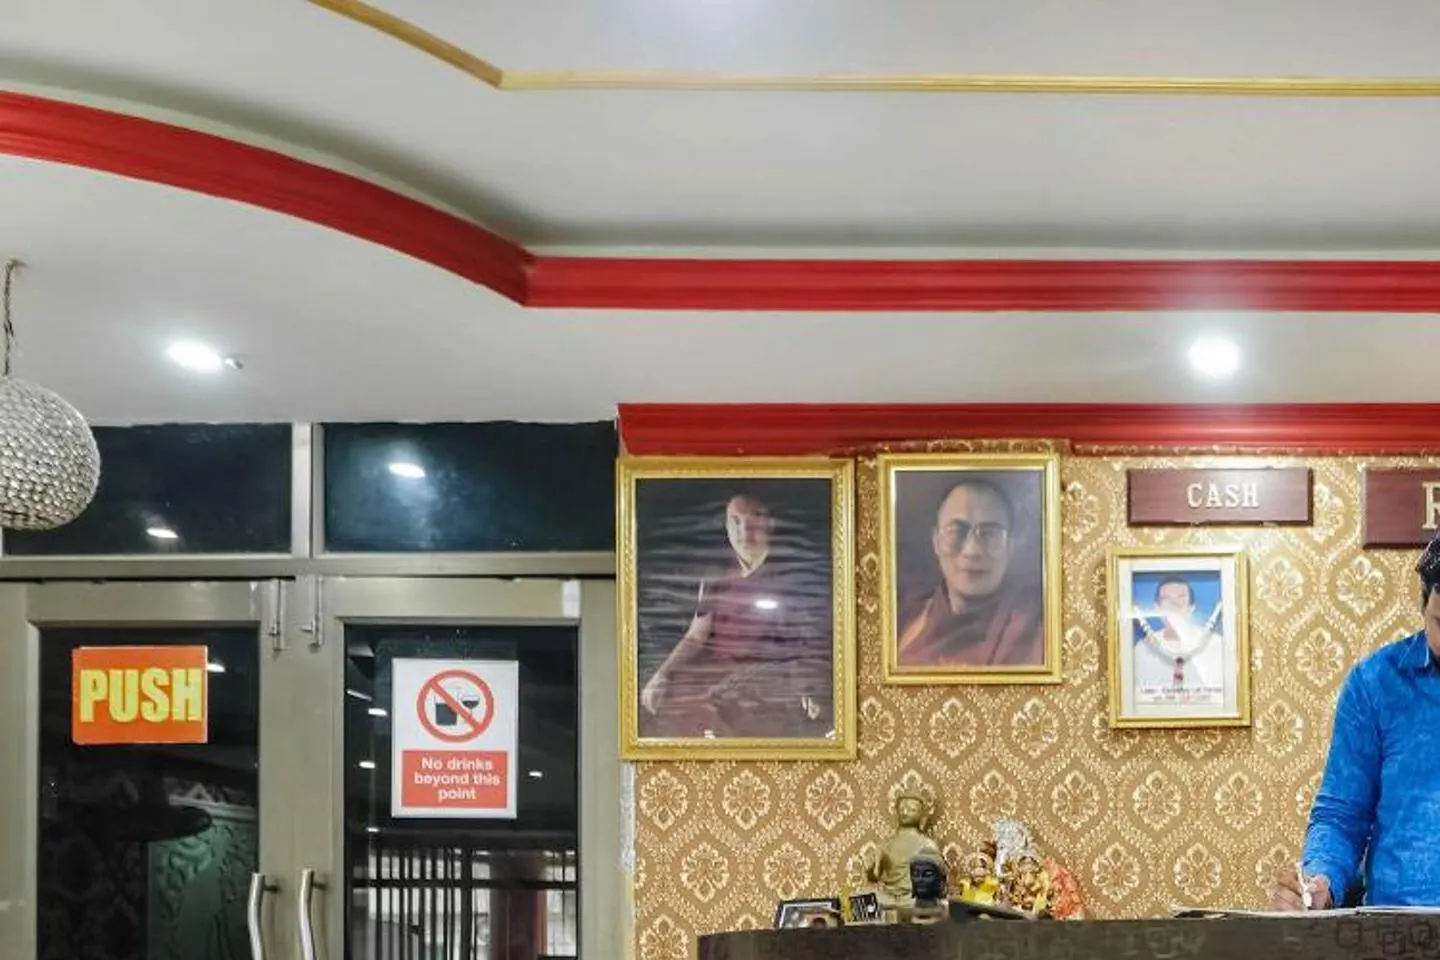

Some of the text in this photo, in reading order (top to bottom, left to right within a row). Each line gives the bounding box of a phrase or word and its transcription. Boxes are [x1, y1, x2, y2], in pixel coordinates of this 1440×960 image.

[1187, 482, 1260, 508] CASH
[79, 667, 203, 723] PUSH
[421, 757, 493, 771] No drinks
[414, 771, 501, 787] beyond this
[438, 786, 477, 803] point
